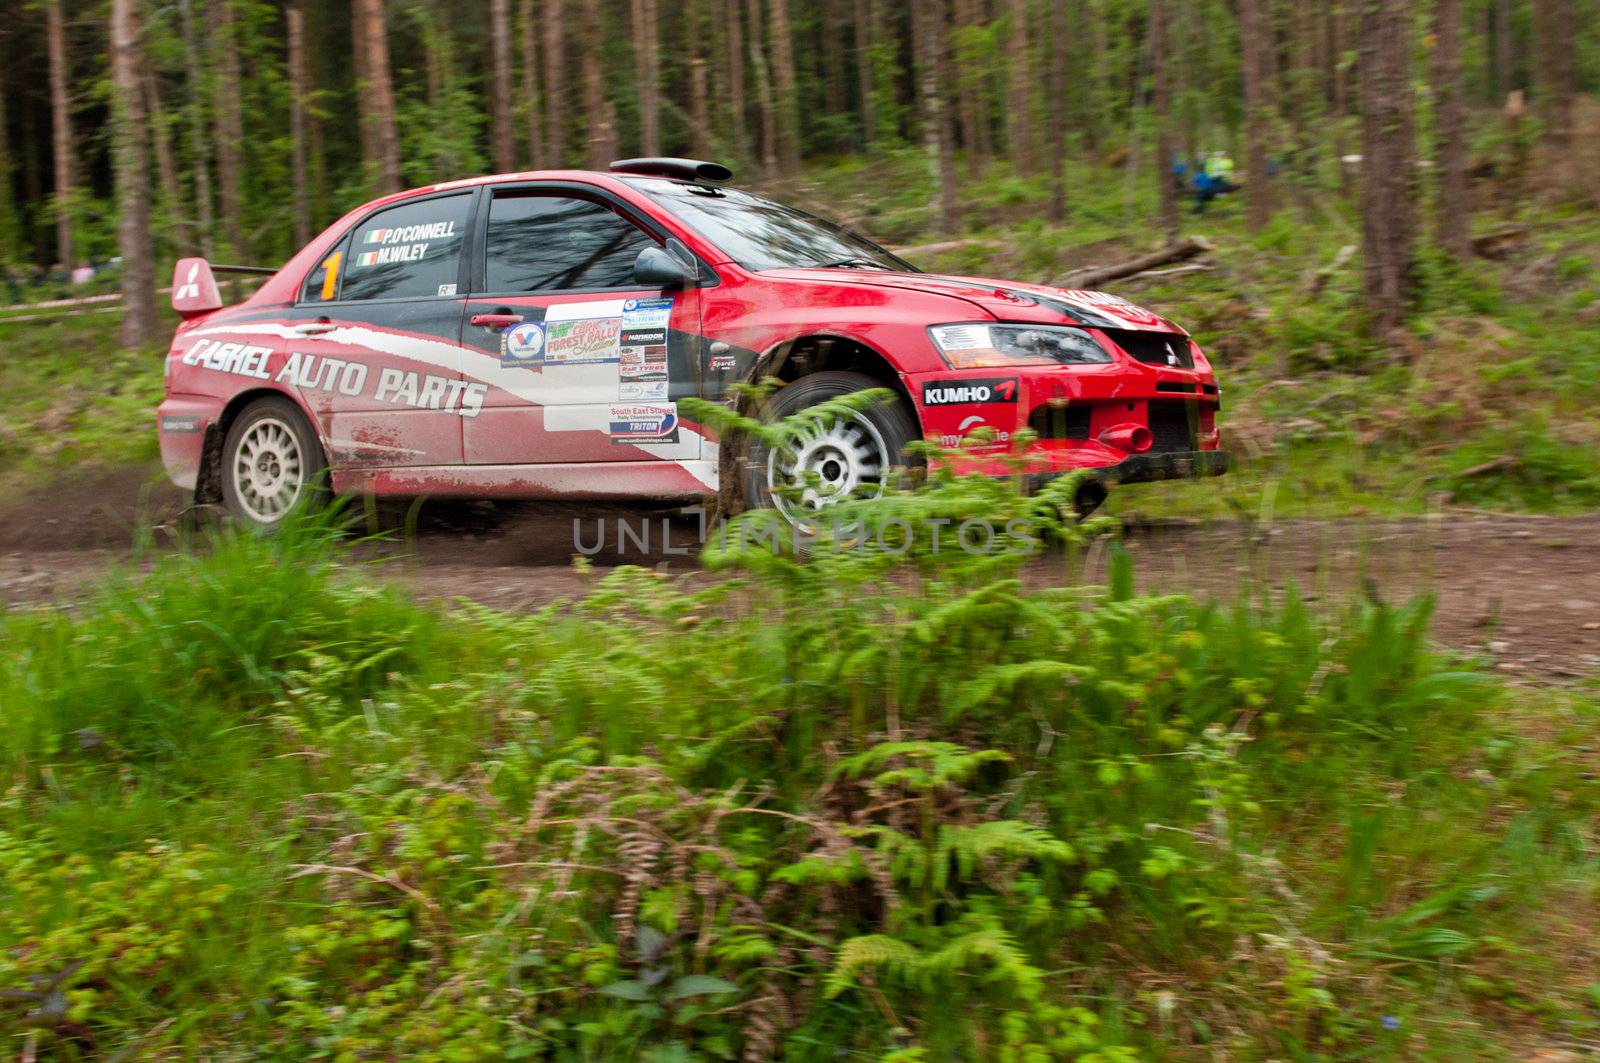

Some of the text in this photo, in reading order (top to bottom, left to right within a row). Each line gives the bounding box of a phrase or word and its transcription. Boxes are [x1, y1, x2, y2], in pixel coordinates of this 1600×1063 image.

[381, 221, 455, 244] P.O'CONNELL
[376, 243, 429, 264] M.WILEY
[320, 251, 343, 301] 1
[547, 333, 586, 354] FOREST
[587, 325, 620, 343] RALLY
[182, 338, 489, 418] CASHEL AUTO PARTS
[925, 386, 991, 404] KUMHO
[650, 407, 675, 415] Stages
[629, 422, 658, 431] TRITON
